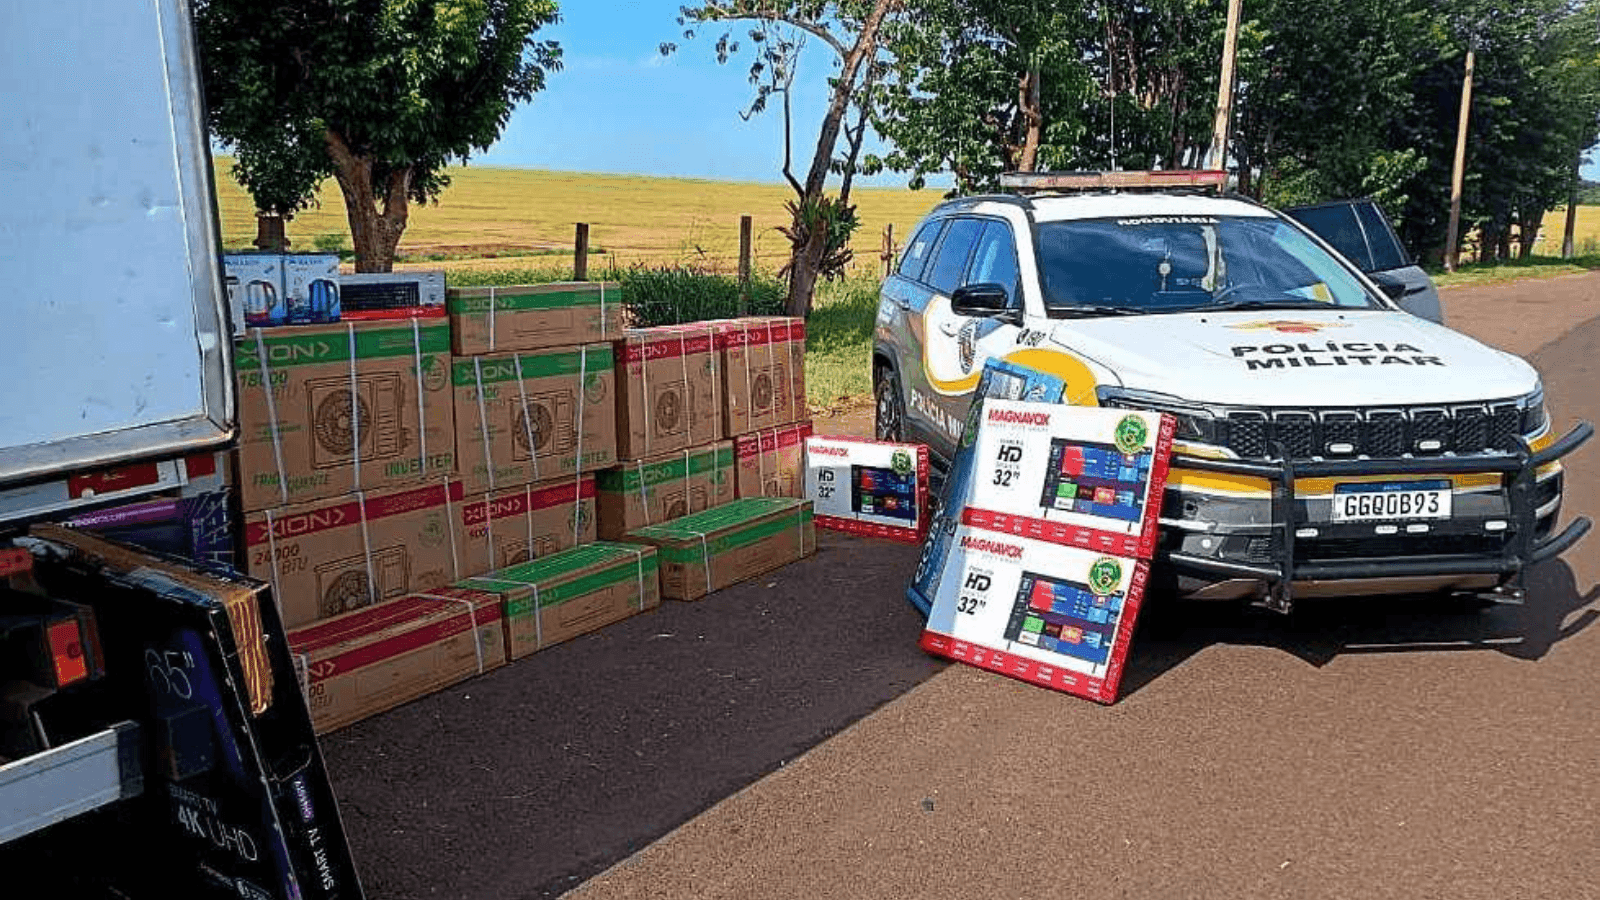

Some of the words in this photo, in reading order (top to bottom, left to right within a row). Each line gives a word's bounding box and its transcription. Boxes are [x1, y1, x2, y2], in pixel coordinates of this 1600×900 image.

[1231, 340, 1424, 358] POLÍCIA
[1246, 355, 1447, 371] MILITAR
[988, 408, 1051, 426] MAGNAVOX
[998, 445, 1022, 462] HD
[818, 468, 835, 482] HD
[993, 469, 1021, 487] 32"
[960, 536, 1025, 560] MAGNAVOX
[965, 572, 992, 592] HD
[957, 596, 987, 616] 32"
[308, 828, 322, 847] TV
[313, 849, 335, 891] SMART
